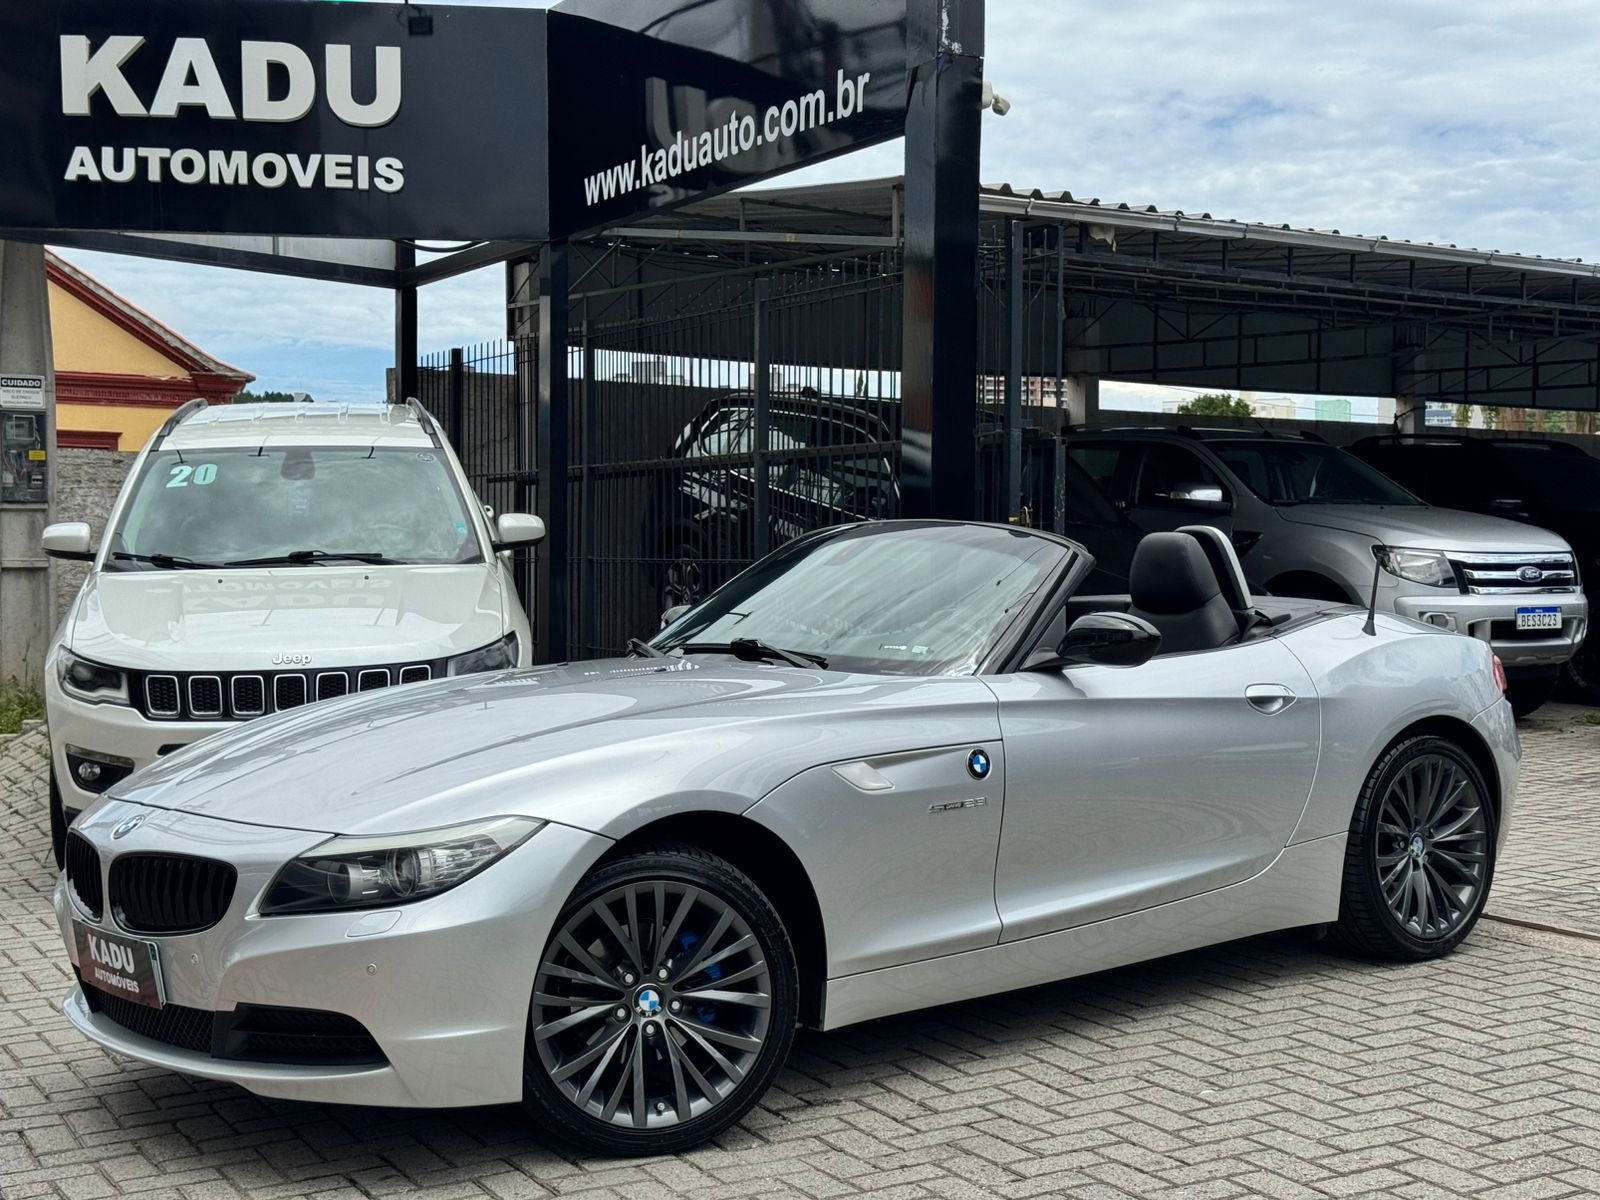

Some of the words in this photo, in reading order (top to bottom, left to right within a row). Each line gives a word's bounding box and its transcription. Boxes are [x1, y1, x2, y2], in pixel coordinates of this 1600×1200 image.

[60, 34, 402, 127] KADU
[584, 69, 870, 206] www.kaduauto.com.br
[64, 146, 404, 193] AUTOMOVEIS
[2, 379, 40, 387] CUIDADO
[166, 463, 218, 488] 20
[1521, 614, 1557, 627] BES3C23
[272, 650, 312, 666] Jeep
[88, 933, 135, 974] KADU
[94, 967, 140, 993] AUTOMÓVEIS
